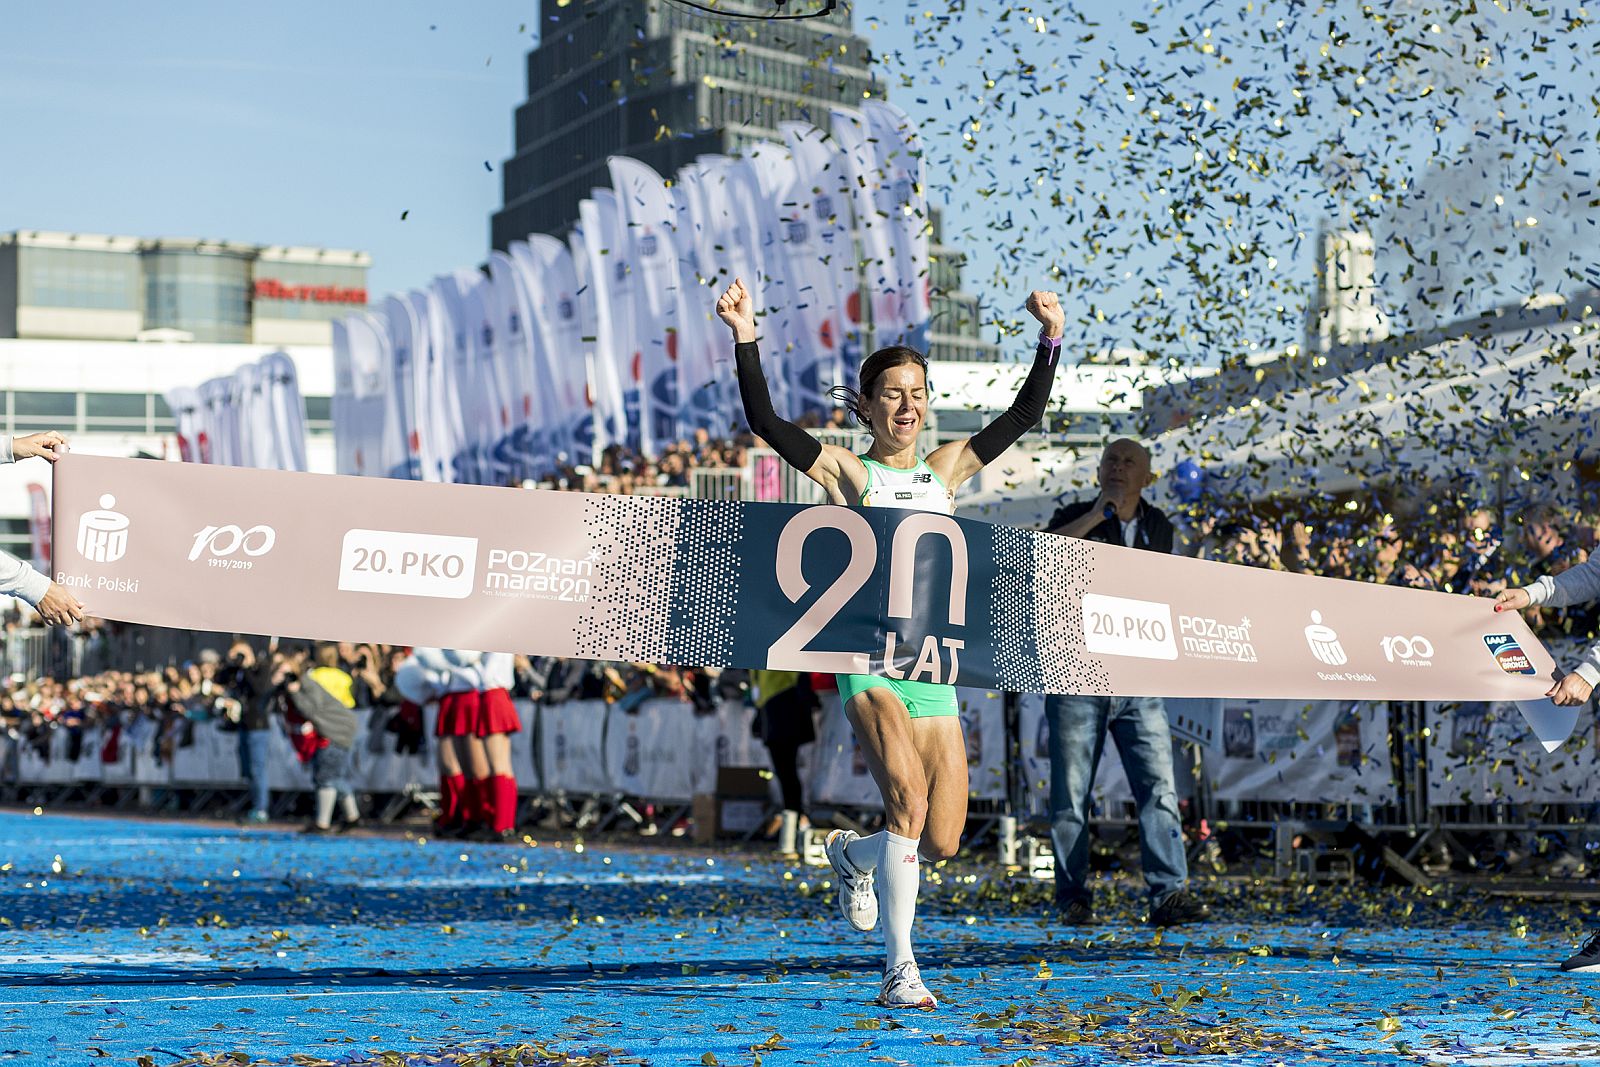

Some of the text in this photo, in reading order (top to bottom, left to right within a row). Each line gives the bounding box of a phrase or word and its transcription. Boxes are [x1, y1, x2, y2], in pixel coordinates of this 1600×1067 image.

[188, 525, 276, 562] 100
[207, 558, 253, 570] 1919/2019
[401, 552, 464, 578] PKO
[57, 572, 139, 593] Bank Polski
[1124, 617, 1166, 642] PKO
[884, 632, 964, 684] LAT
[1380, 635, 1435, 663] 100
